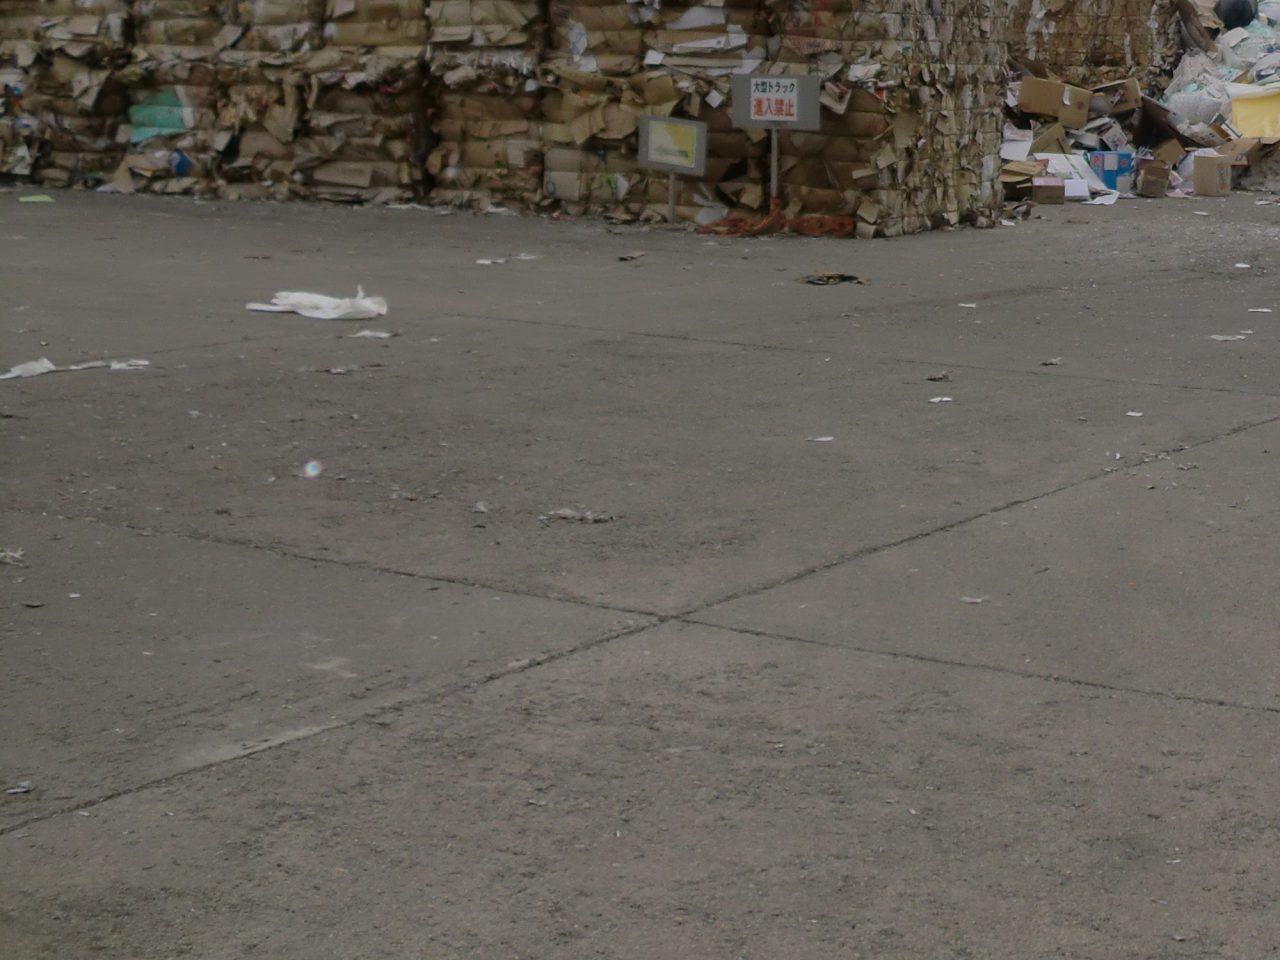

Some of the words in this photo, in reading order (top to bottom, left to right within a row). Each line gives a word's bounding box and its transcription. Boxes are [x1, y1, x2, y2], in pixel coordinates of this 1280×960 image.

[753, 80, 796, 93] 大型トラック
[753, 98, 795, 117] 進入禁止
